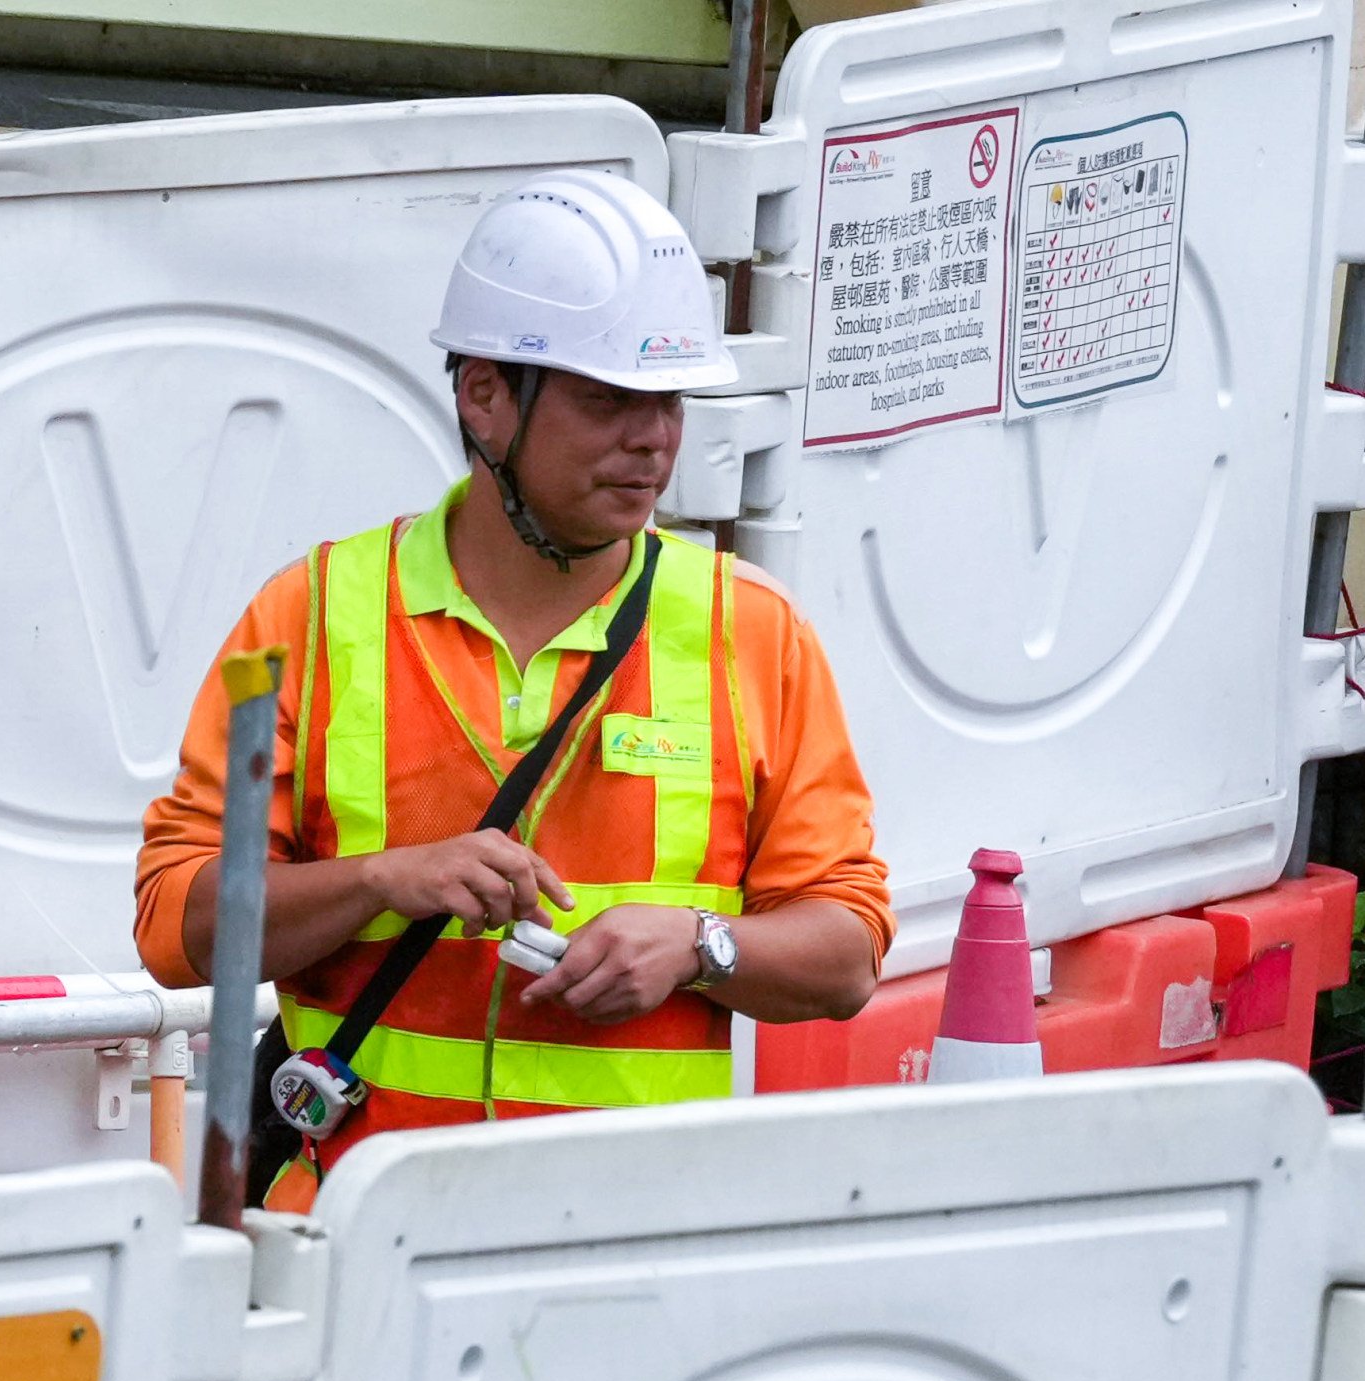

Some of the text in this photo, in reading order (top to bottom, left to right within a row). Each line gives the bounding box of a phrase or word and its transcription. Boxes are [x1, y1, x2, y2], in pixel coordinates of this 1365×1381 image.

[835, 290, 981, 336] Smoking is strictly prohibited in all
[827, 342, 874, 363] statutory
[877, 330, 920, 358] no-smoking
[944, 317, 984, 341] including
[815, 370, 849, 391] indoor
[852, 369, 882, 387] areas,
[926, 350, 959, 371] housing
[960, 345, 992, 365] estates,
[908, 379, 921, 402] and
[922, 377, 945, 401] parks
